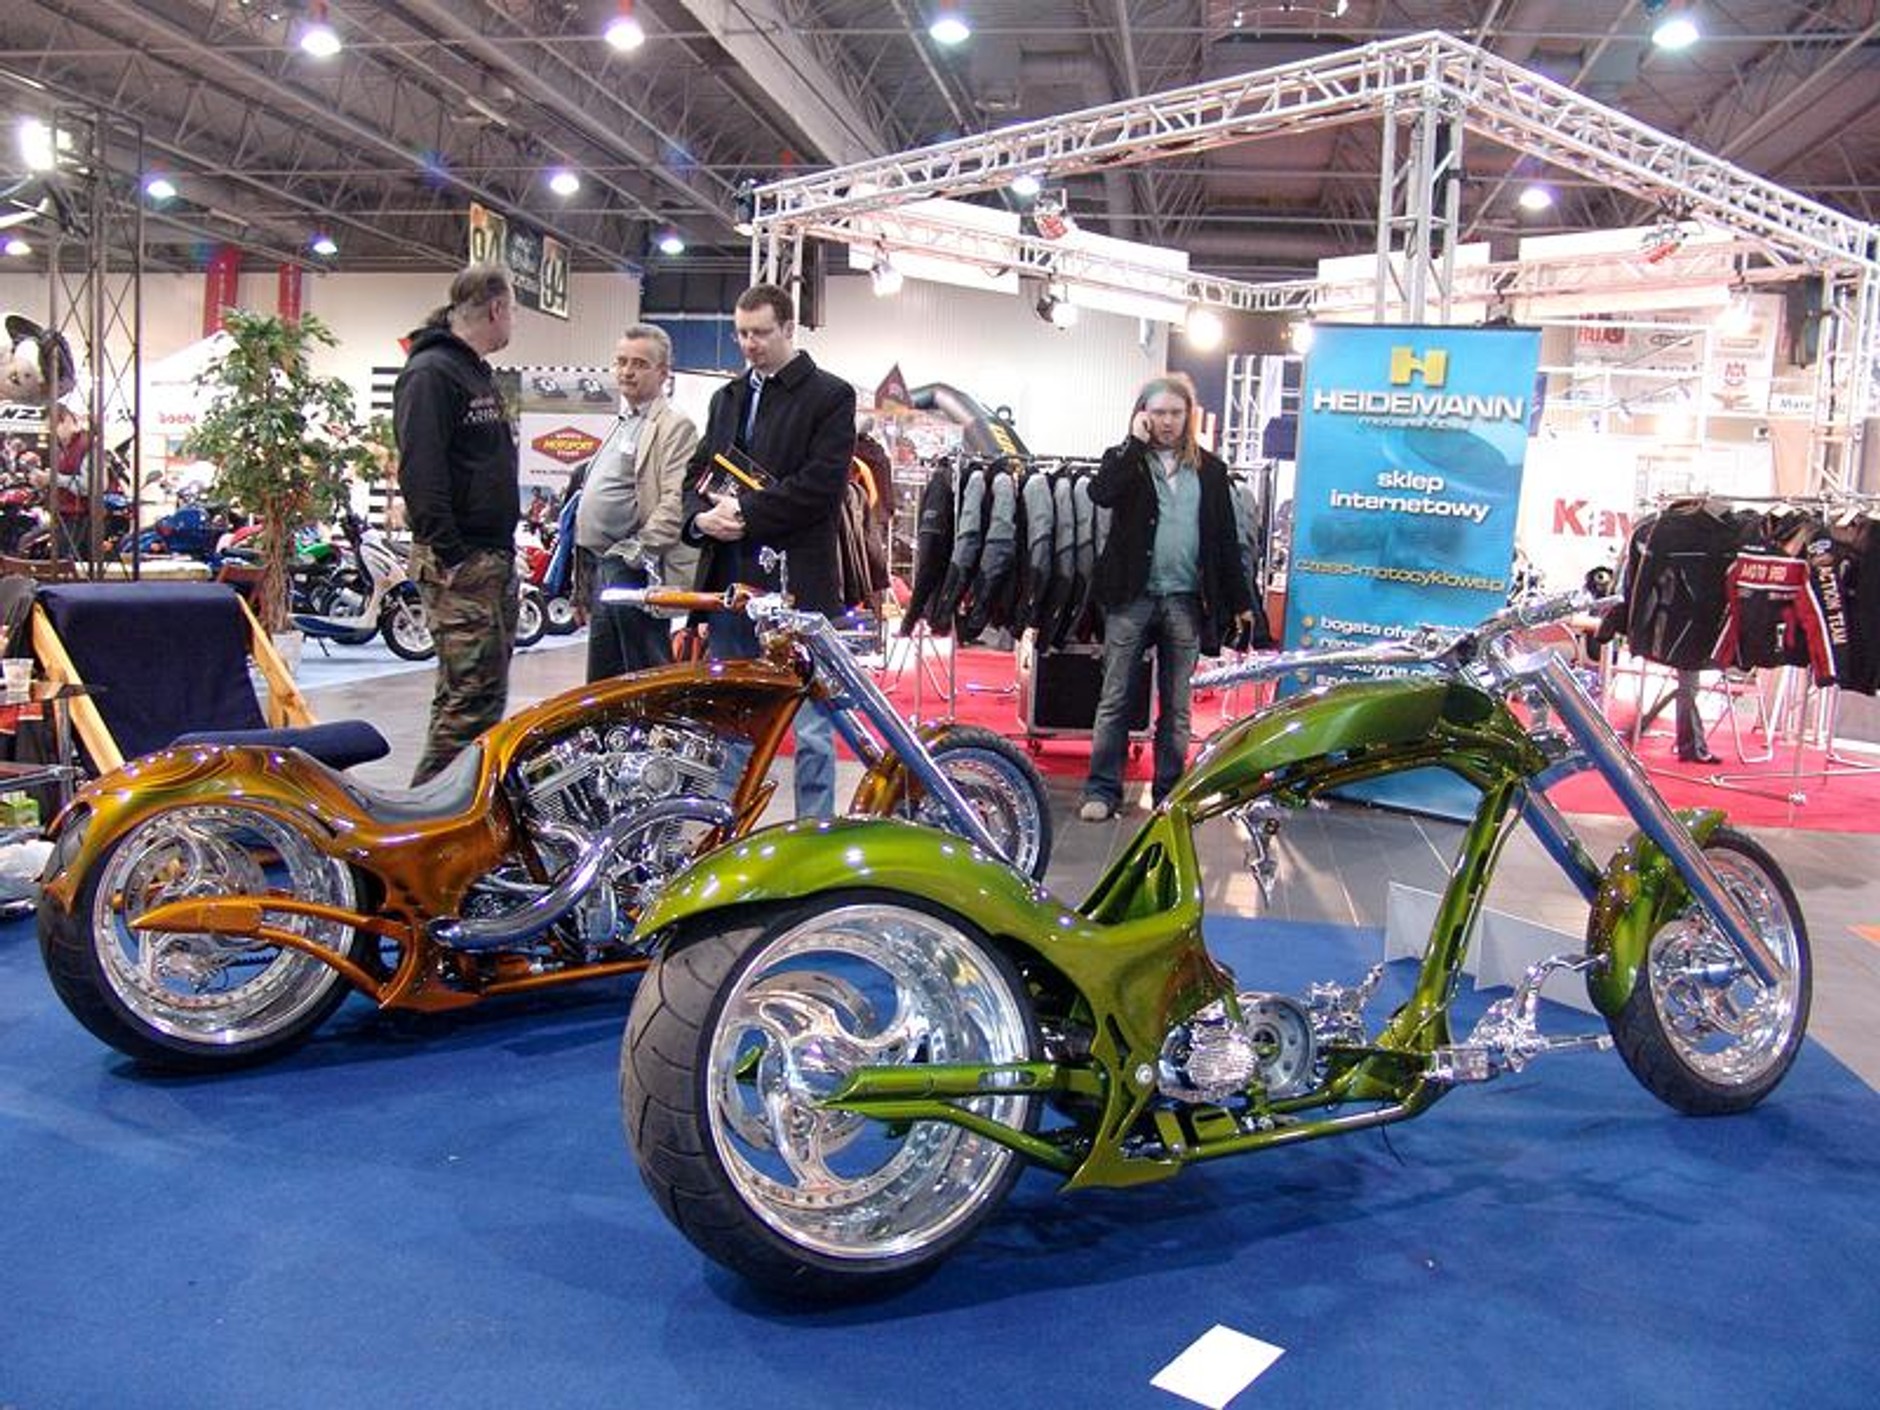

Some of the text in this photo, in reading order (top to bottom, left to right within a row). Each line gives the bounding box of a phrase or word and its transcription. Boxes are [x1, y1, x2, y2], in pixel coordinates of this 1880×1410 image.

[1390, 346, 1447, 386] H
[1313, 388, 1524, 420] HEIDEMANN
[1376, 470, 1445, 495] sklep
[1329, 488, 1491, 523] internetowy
[1320, 616, 1380, 636] bogata
